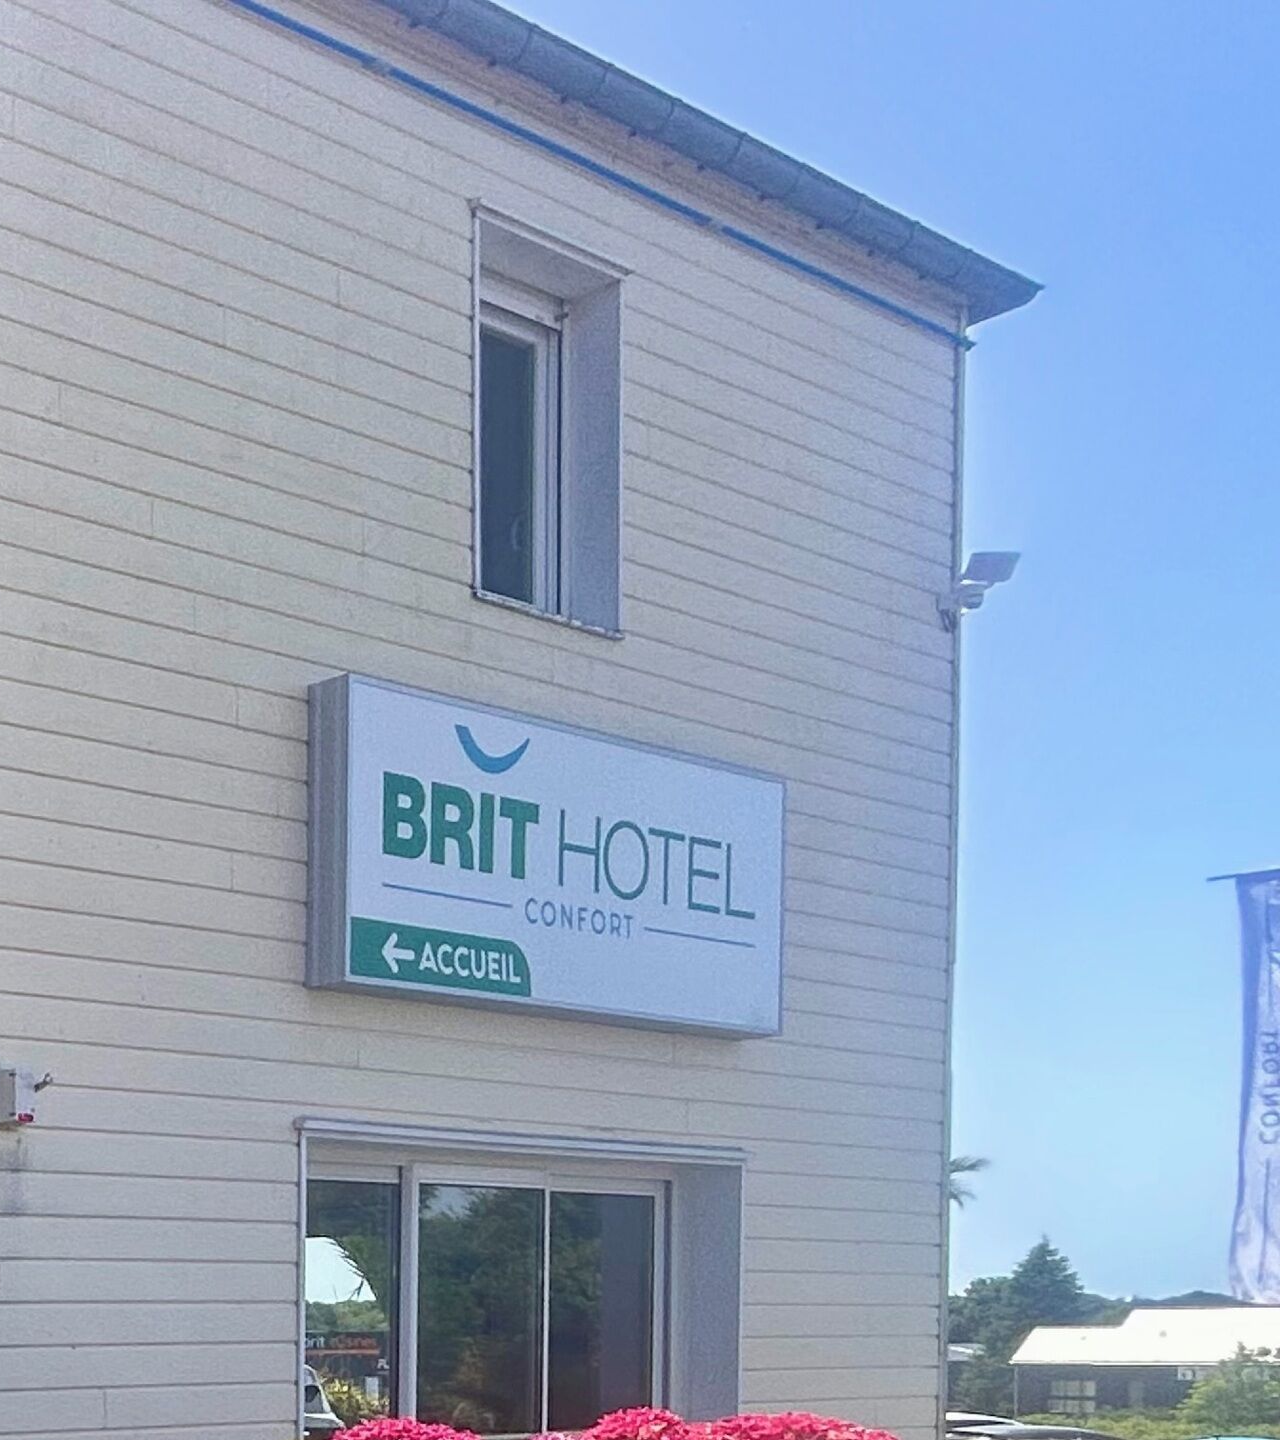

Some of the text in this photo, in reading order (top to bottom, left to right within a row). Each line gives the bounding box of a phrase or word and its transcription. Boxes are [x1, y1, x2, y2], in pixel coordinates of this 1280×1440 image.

[382, 771, 756, 920] BRIT HOTEL
[524, 897, 635, 940] CONFORT
[418, 942, 522, 985] ACCUEIL
